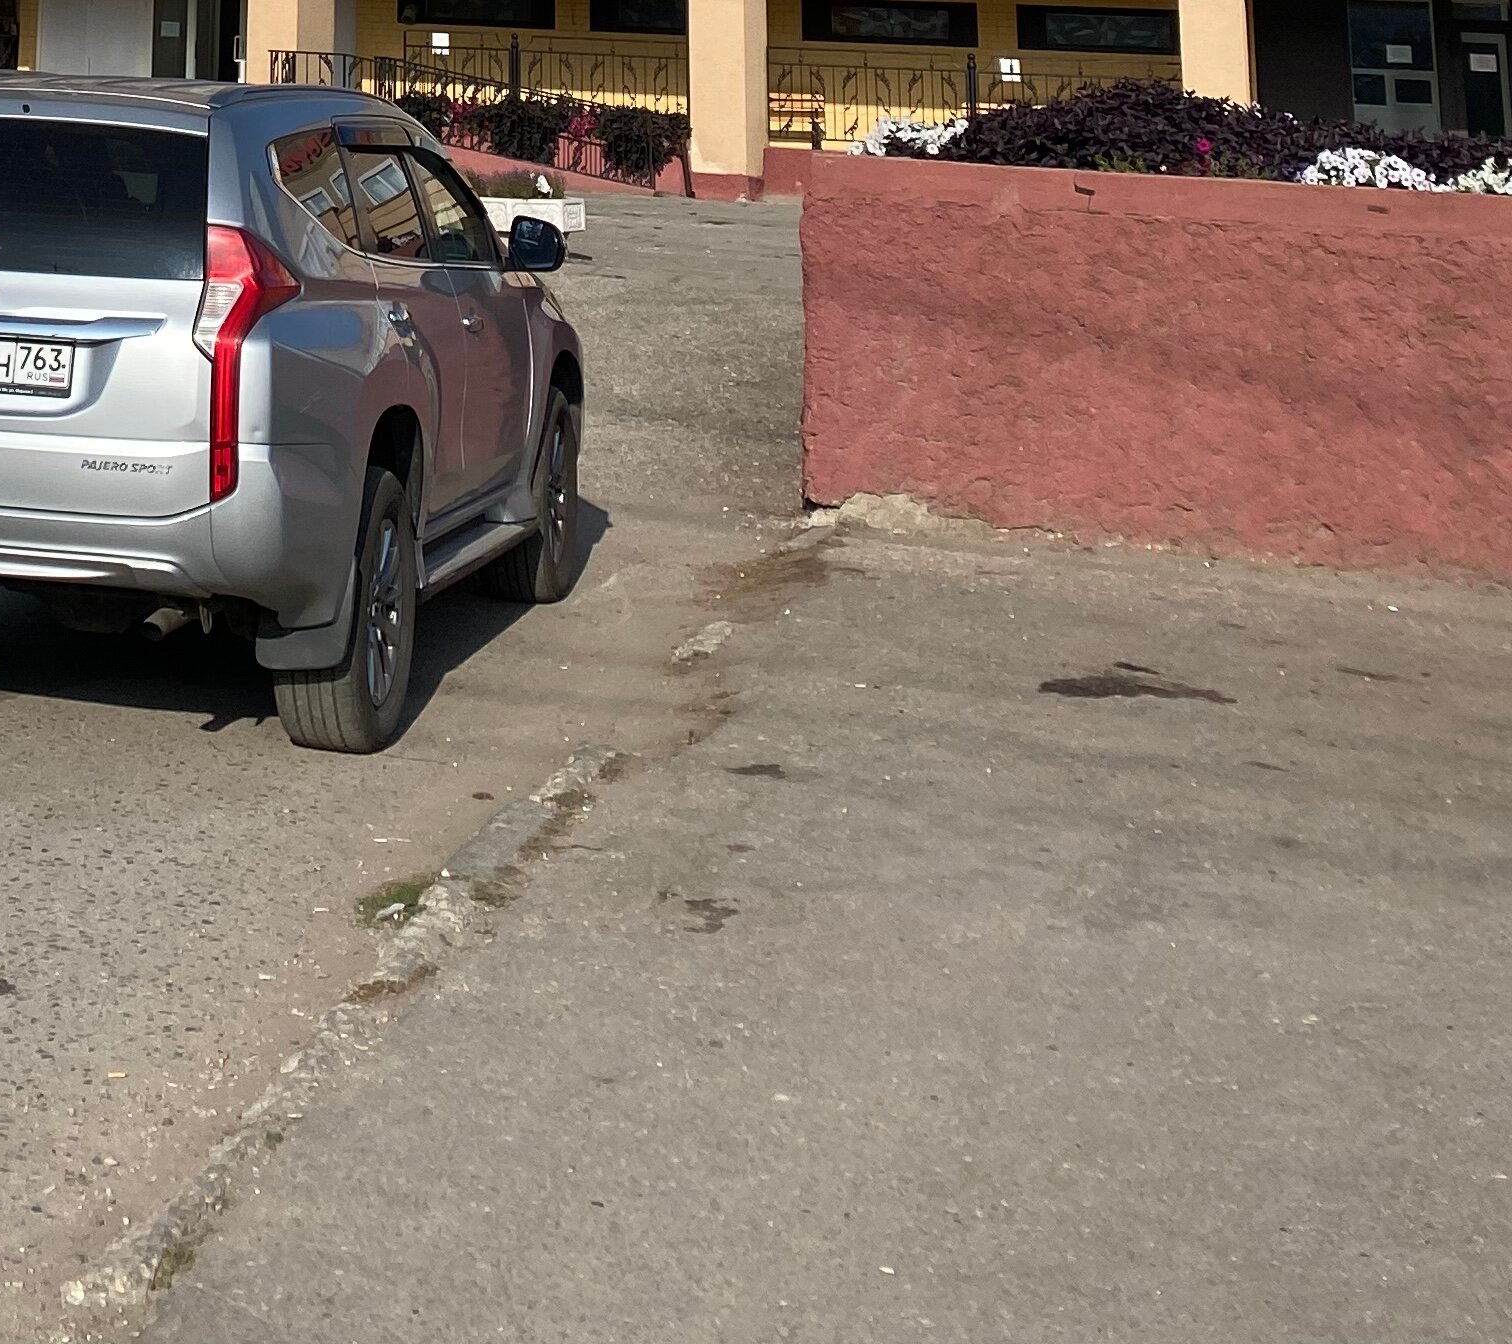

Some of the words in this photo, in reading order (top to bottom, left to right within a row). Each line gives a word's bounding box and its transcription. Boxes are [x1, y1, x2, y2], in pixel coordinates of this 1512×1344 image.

[19, 345, 63, 372] 763
[26, 371, 48, 382] RUS
[80, 459, 128, 472] PAJERO
